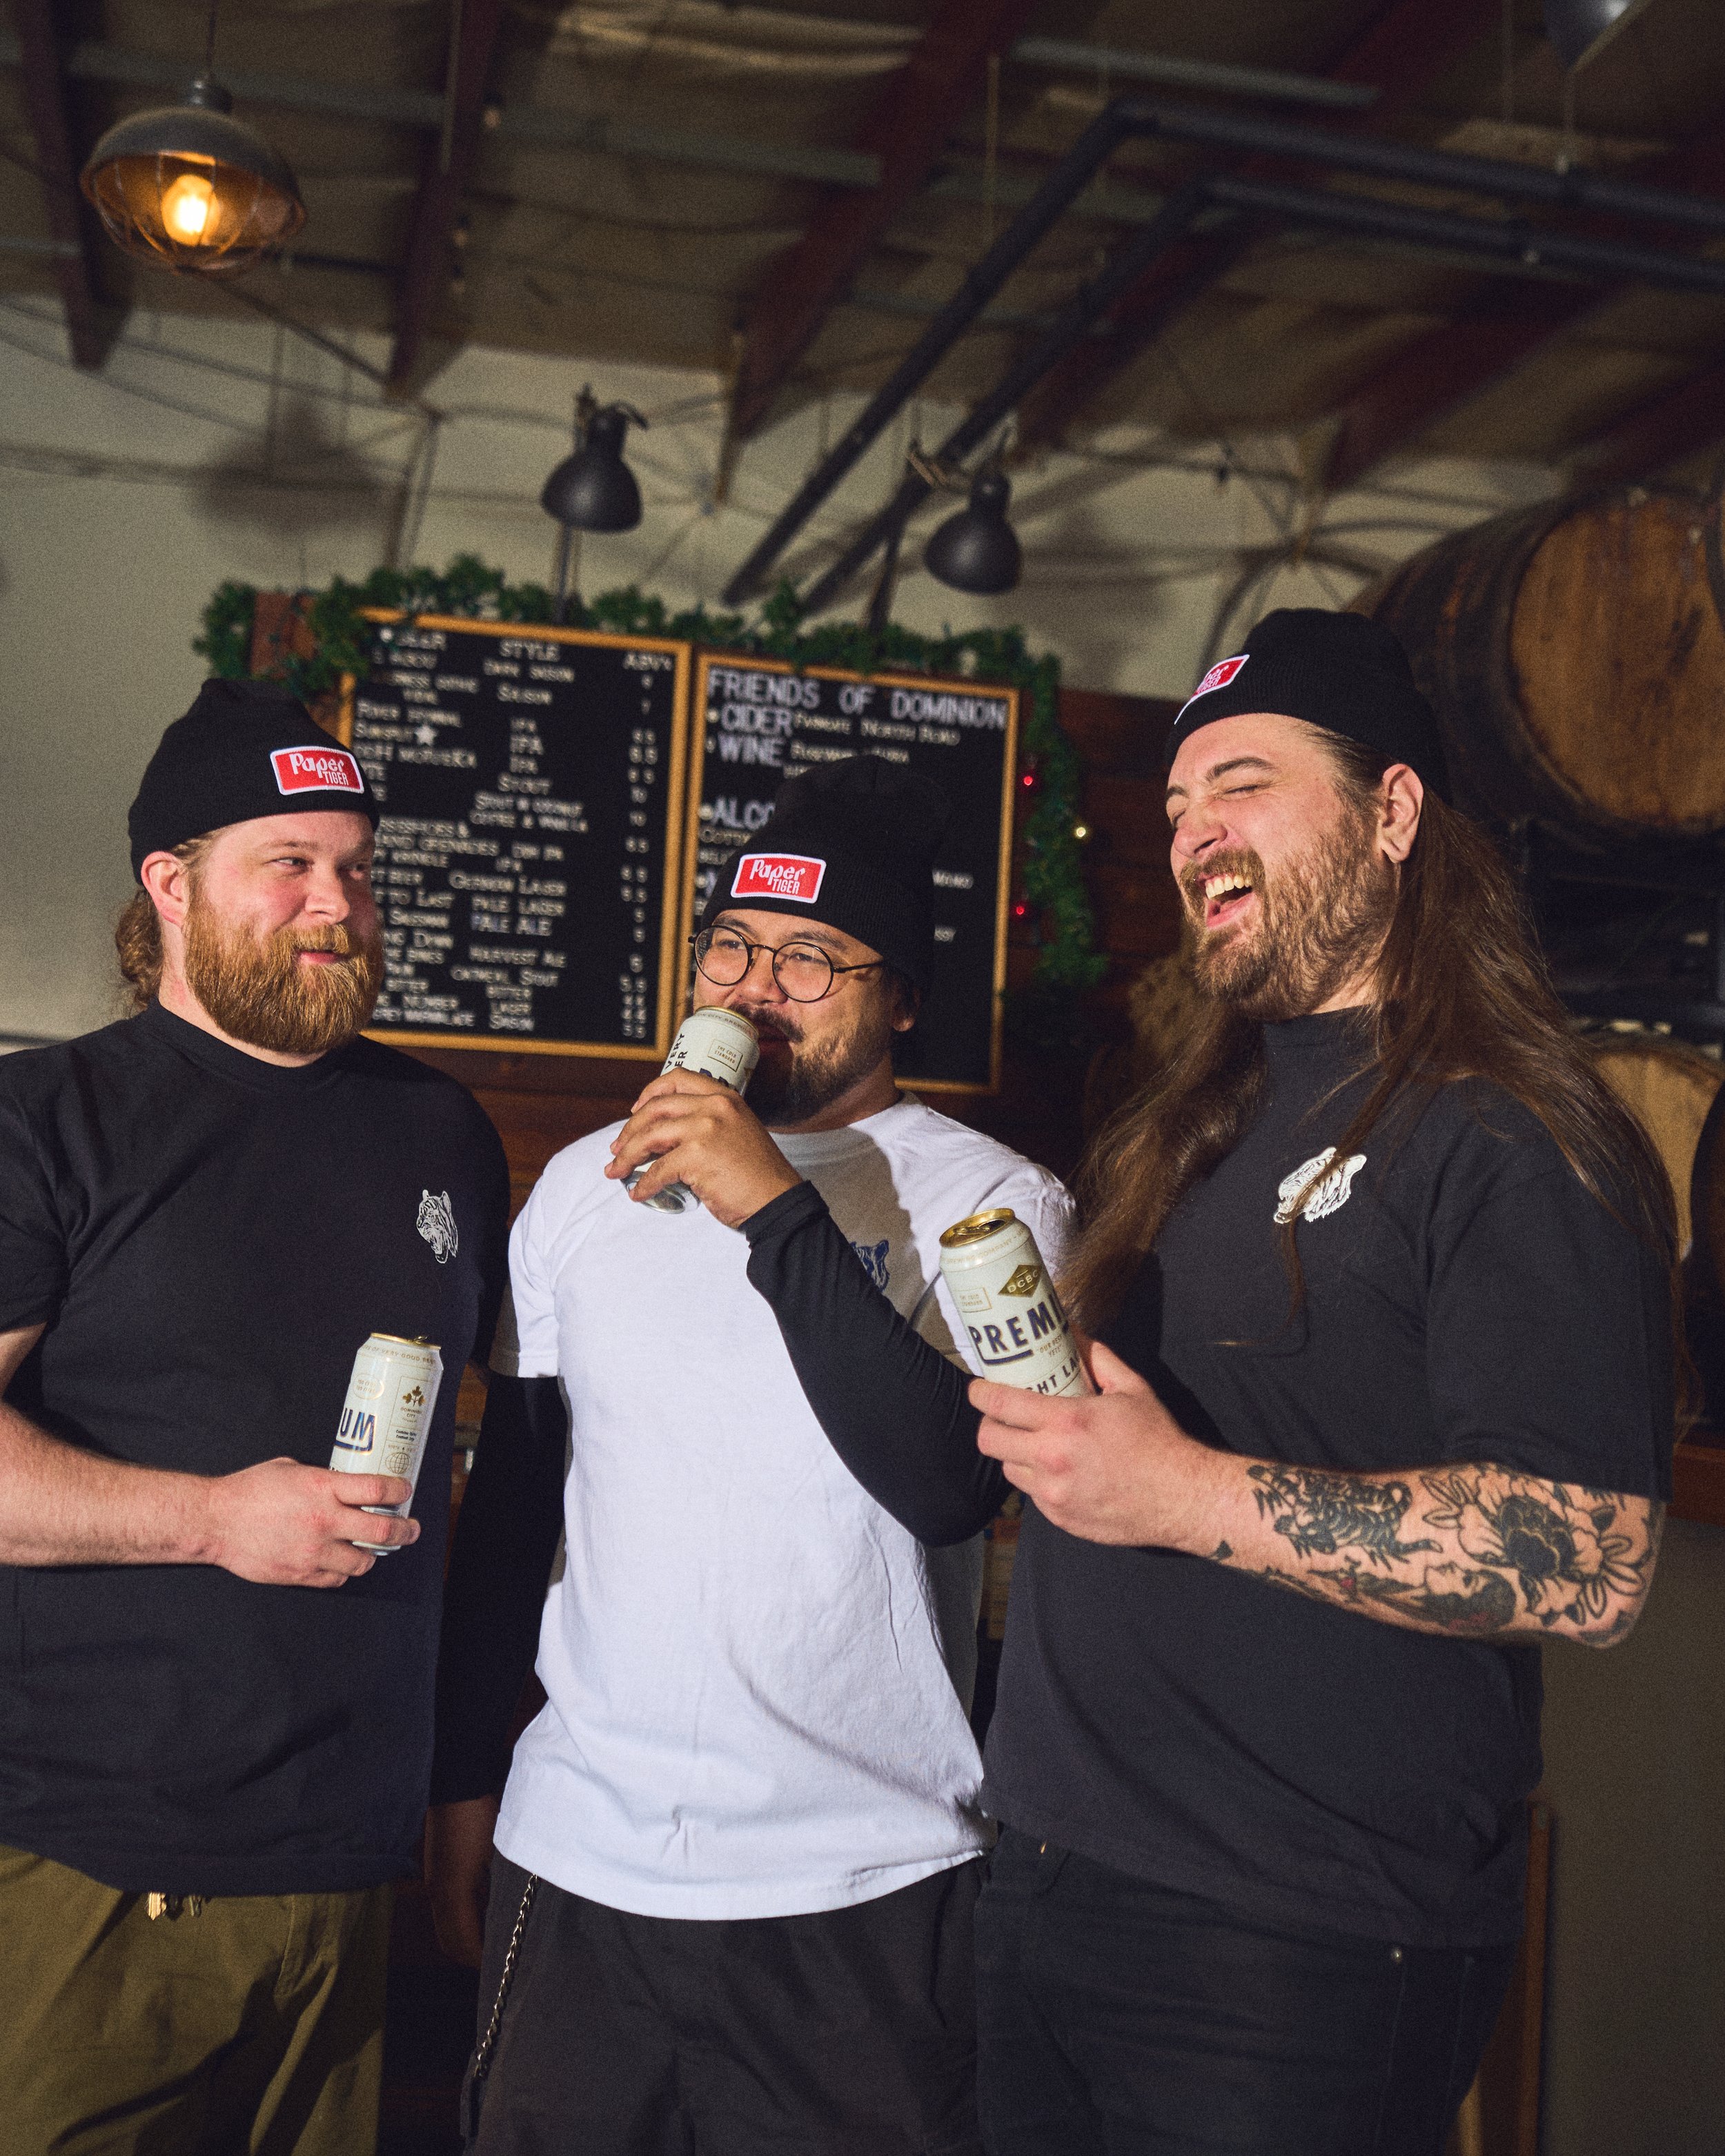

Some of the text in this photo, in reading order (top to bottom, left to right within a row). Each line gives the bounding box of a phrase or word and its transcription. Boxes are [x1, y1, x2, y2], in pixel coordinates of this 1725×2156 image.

[708, 668, 1009, 731] FRIENDS OF DOMINION
[720, 702, 793, 738] CIDER
[718, 733, 785, 767] WINE
[289, 753, 344, 778] Paper
[323, 771, 348, 785] TIGER
[749, 859, 806, 886] Paper
[772, 878, 800, 895] TIGER
[1007, 1269, 1038, 1294] DCBC
[401, 1353, 420, 1362] GOOD
